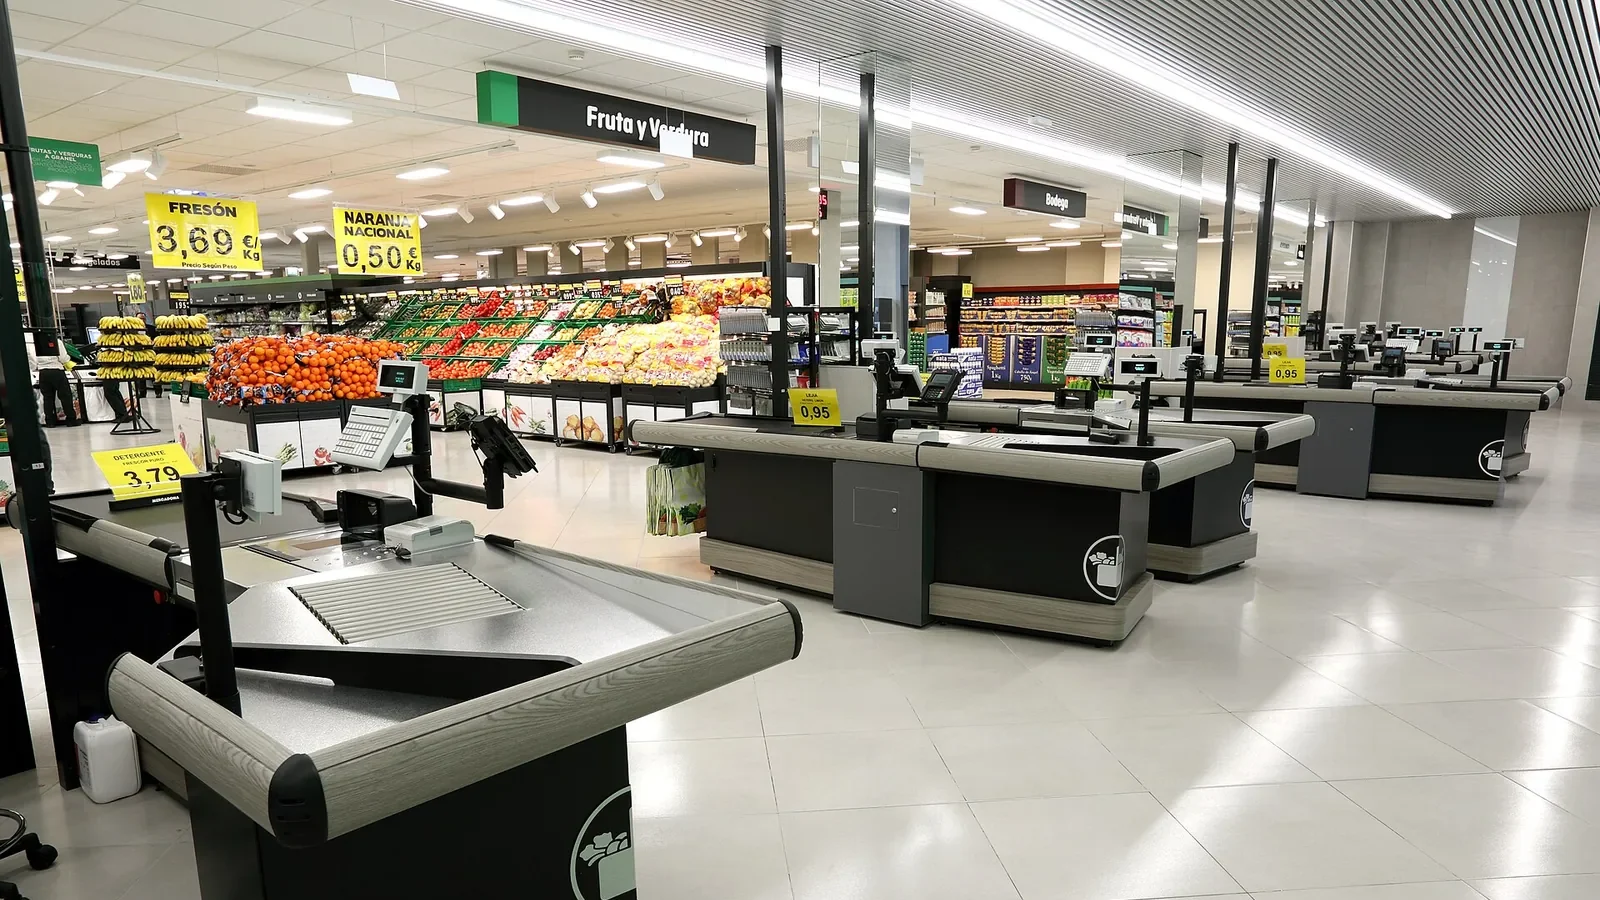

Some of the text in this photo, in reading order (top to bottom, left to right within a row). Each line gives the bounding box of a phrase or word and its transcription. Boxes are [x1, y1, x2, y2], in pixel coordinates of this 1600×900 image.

[586, 105, 633, 134] Fruta
[636, 119, 647, 141] y
[58, 150, 93, 160] VERDURAS
[1045, 192, 1069, 209] Bodega
[169, 202, 237, 218] FRESÓN
[344, 211, 411, 228] NARANJA
[344, 226, 414, 239] NACIONAL
[156, 225, 233, 259] 3,69
[70, 257, 121, 267] Cgelados
[243, 250, 260, 261] Kg
[342, 243, 418, 273] 0,50 €
[406, 259, 421, 271] Kg
[1275, 369, 1297, 379] 0,95
[800, 405, 830, 420] 0,95
[113, 450, 166, 461] DETERGENTE
[122, 457, 165, 467] FRESCOR PURO
[123, 465, 181, 490] 3,79
